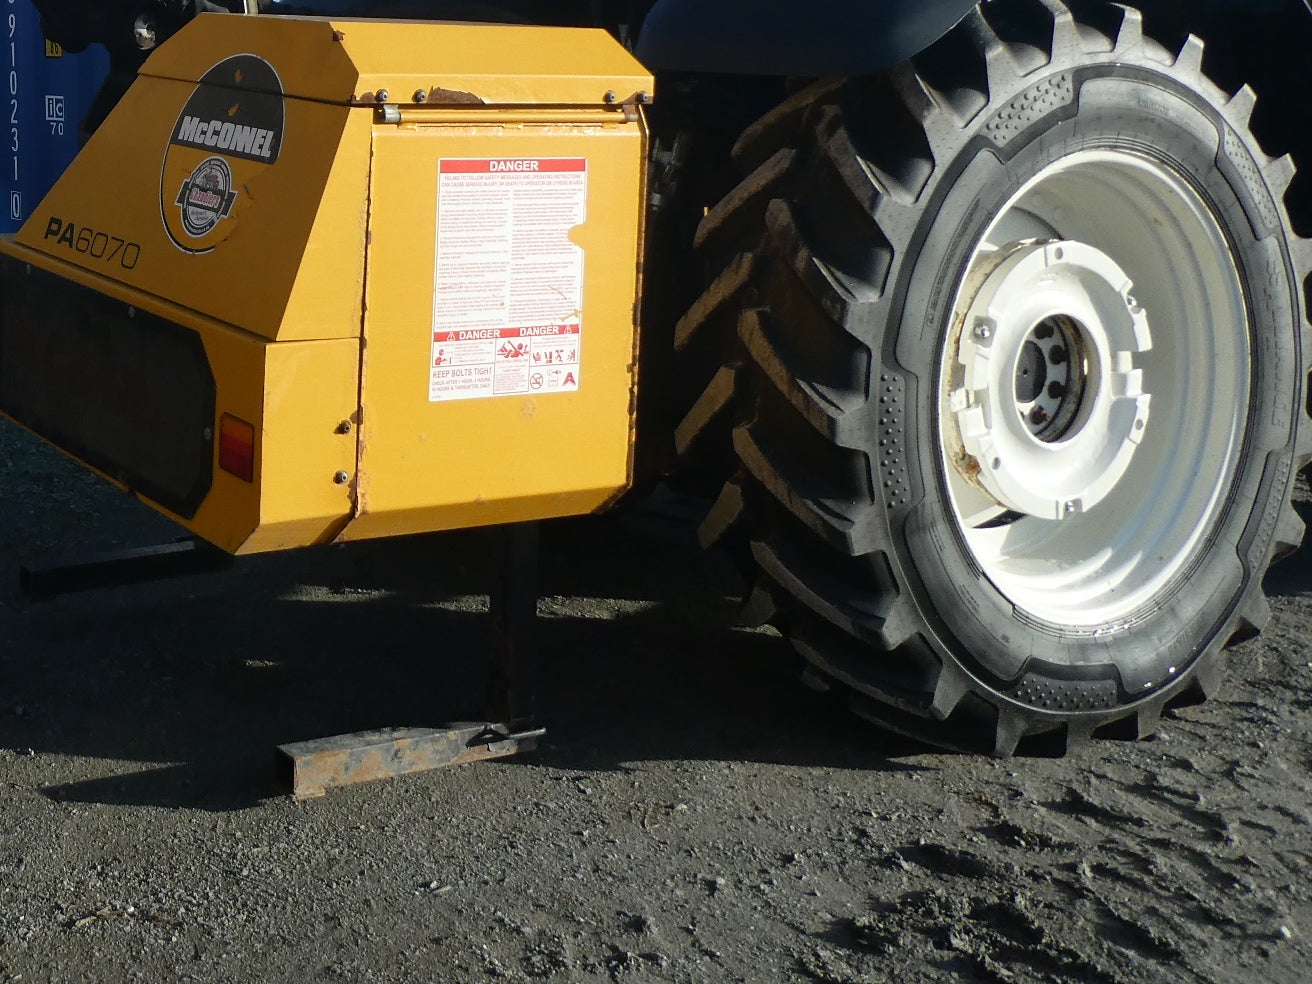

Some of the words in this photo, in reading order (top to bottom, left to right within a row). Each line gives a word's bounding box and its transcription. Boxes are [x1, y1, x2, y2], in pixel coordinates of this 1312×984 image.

[8, 13, 19, 181] 910231
[50, 122, 64, 136] 70
[177, 115, 274, 158] McCONNEL
[489, 160, 539, 172] DANGER
[44, 216, 141, 270] PA6070
[459, 329, 501, 340] DANGER
[519, 325, 560, 336] DANGER
[432, 370, 450, 378] KEEP
[451, 368, 473, 377] BOLTS
[474, 367, 493, 376] TIGHT
